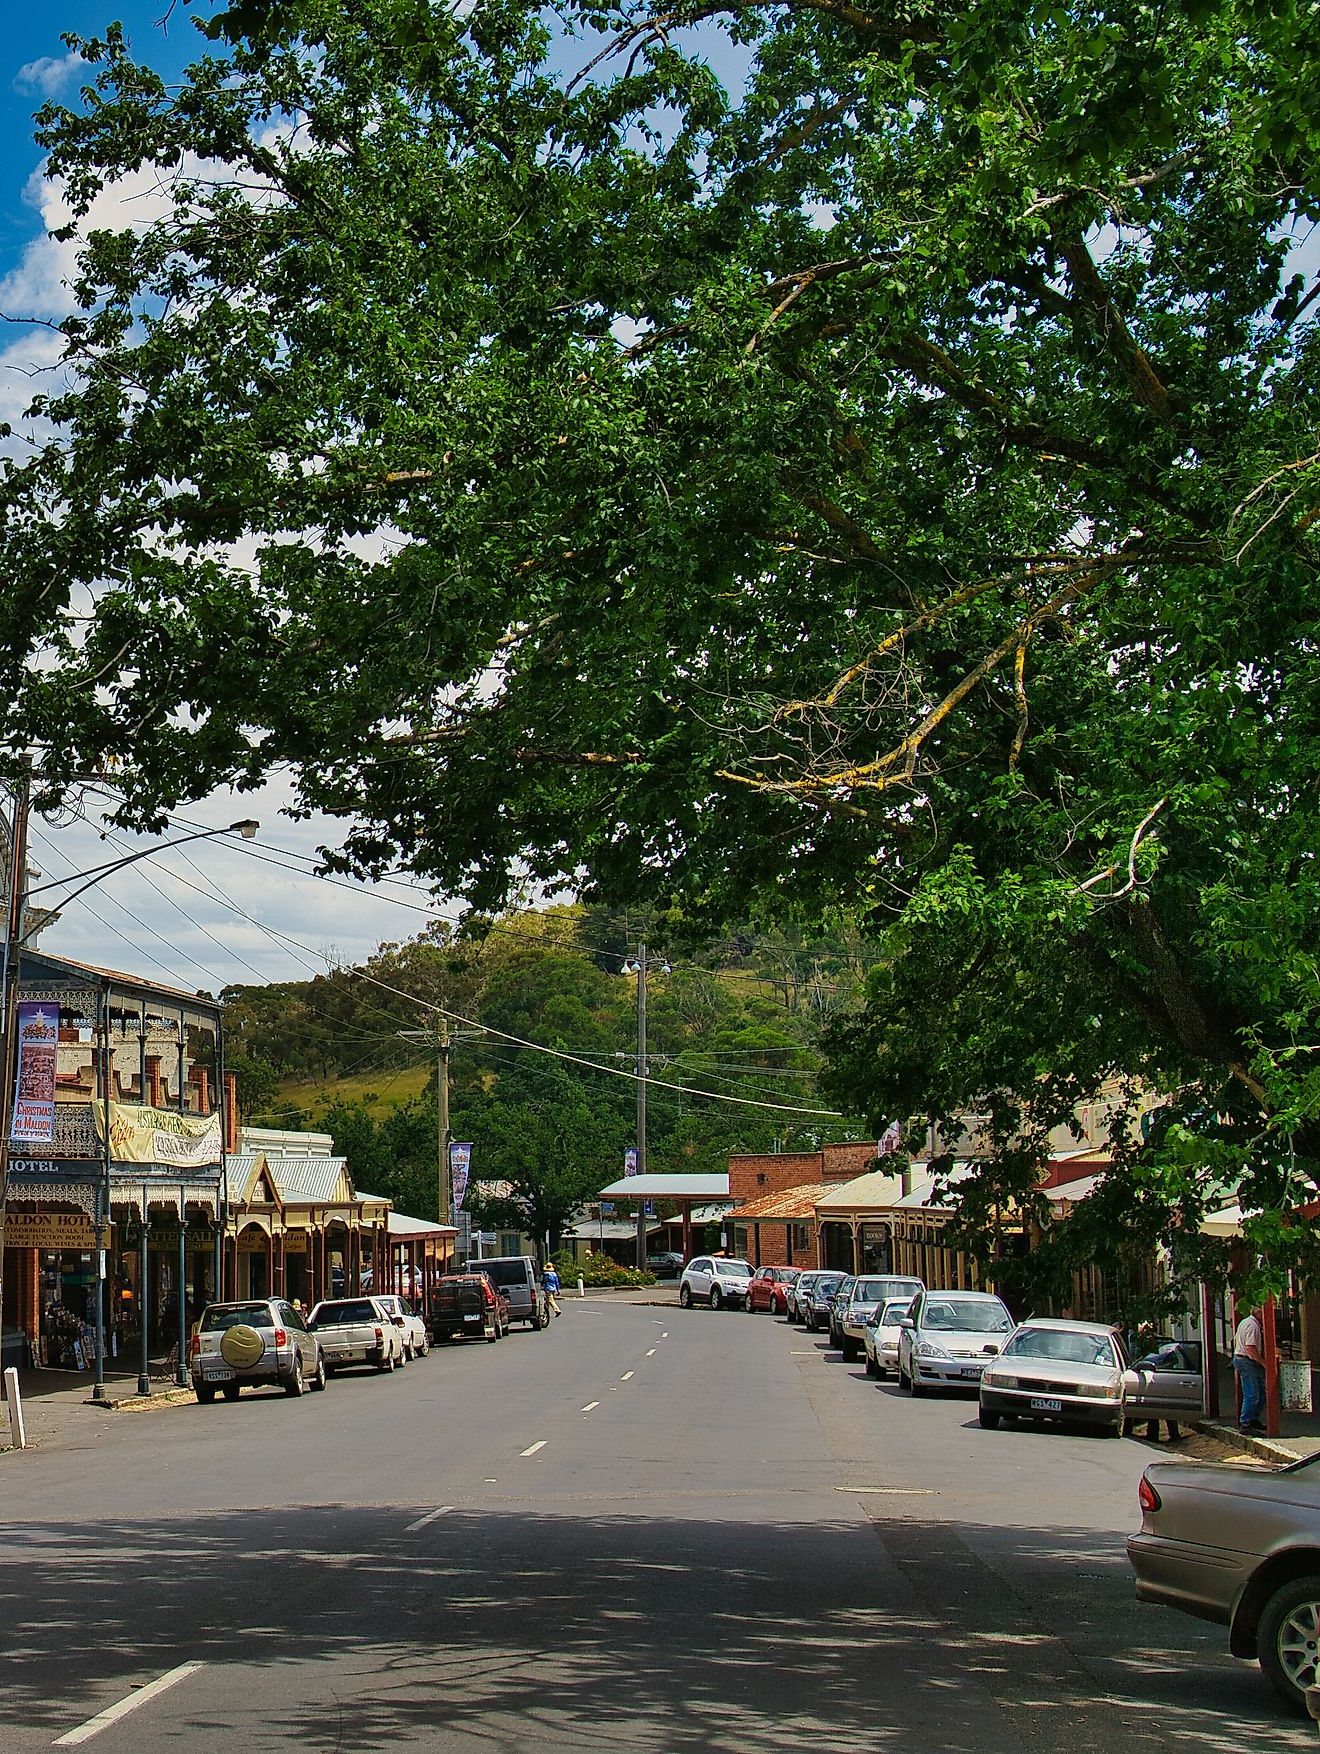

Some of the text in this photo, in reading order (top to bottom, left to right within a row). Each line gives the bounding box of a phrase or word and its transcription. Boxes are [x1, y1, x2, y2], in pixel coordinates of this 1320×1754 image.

[17, 1101, 52, 1117] CHRISTMAS
[24, 1116, 51, 1130] MALDON
[5, 1214, 91, 1226] ALDON HOT
